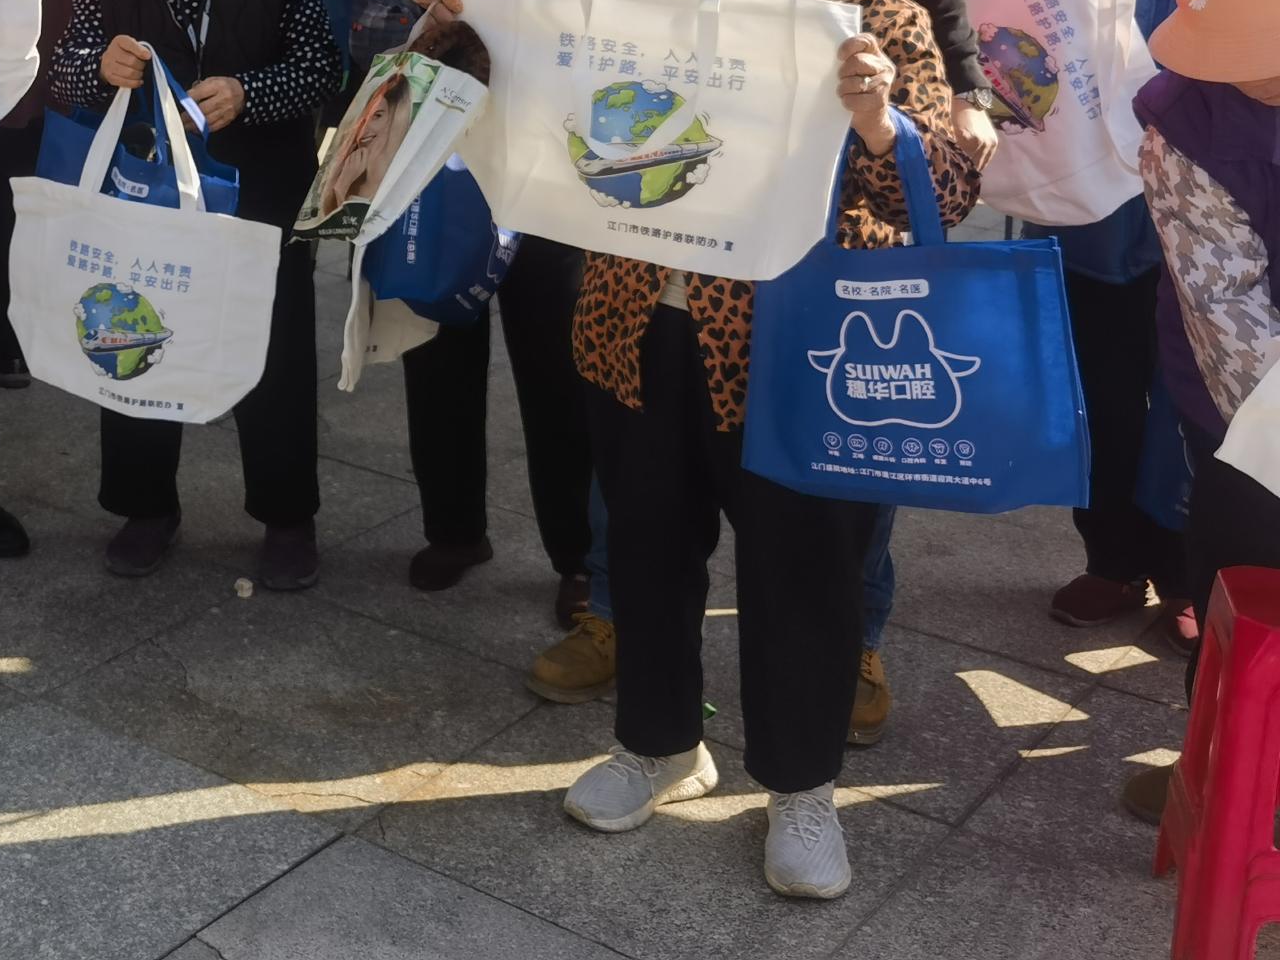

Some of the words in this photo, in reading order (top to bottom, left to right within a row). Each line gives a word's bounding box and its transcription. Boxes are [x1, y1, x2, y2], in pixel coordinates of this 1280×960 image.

[556, 51, 745, 91] 爱护路，平安出行
[844, 362, 932, 380] SUIWAH
[846, 380, 936, 400] 穗华口腔
